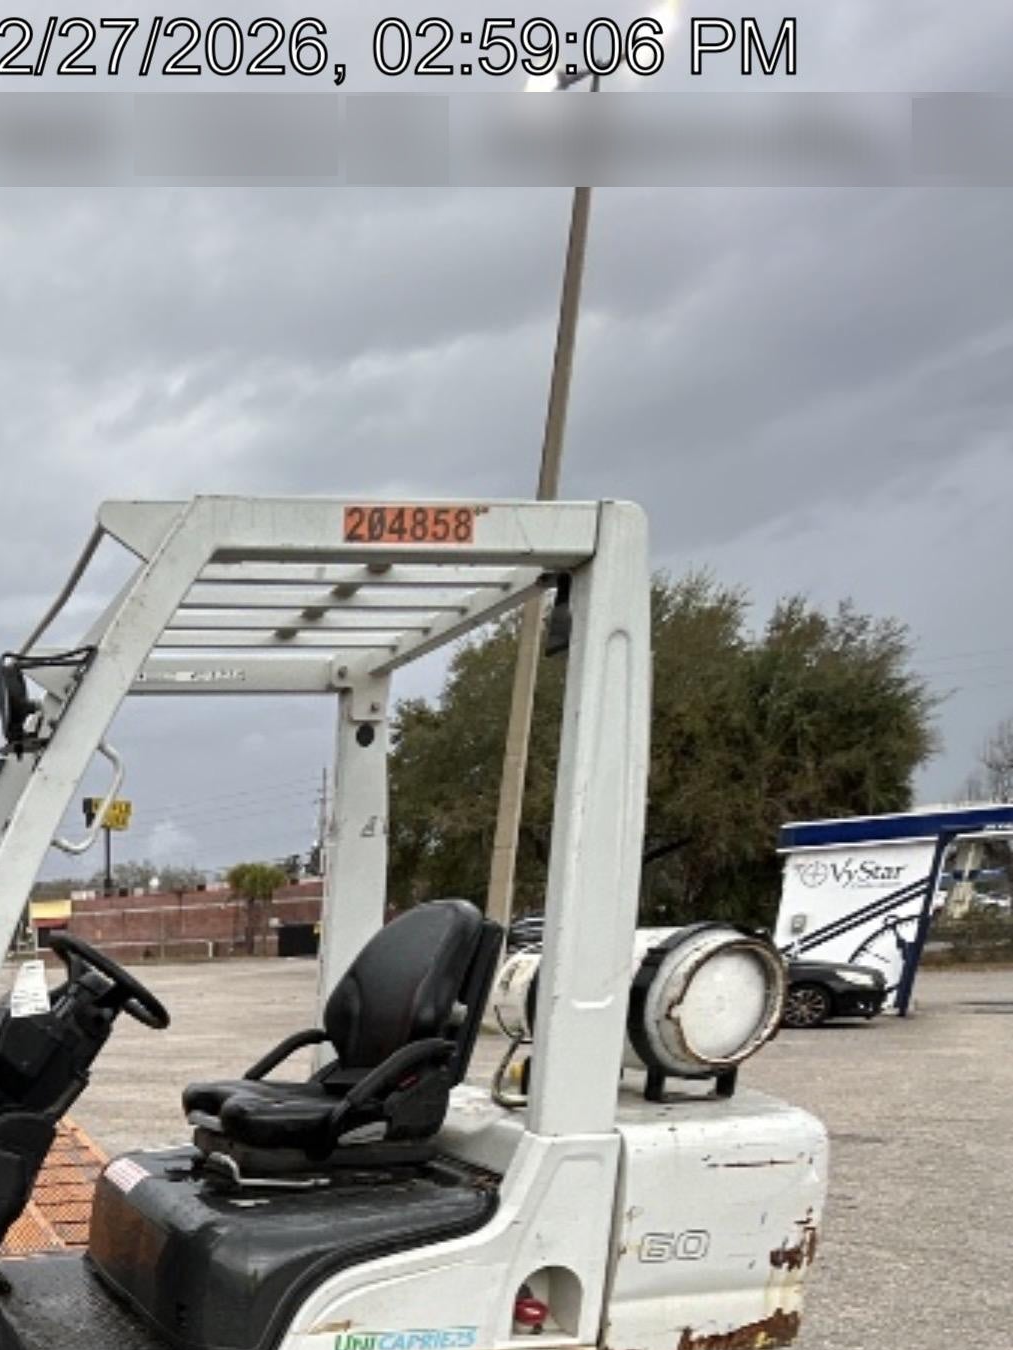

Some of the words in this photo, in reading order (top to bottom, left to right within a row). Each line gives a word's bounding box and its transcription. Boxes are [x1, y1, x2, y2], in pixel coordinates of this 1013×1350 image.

[345, 506, 472, 542] 204858
[830, 858, 907, 888] VyStar
[638, 1229, 711, 1263] 60
